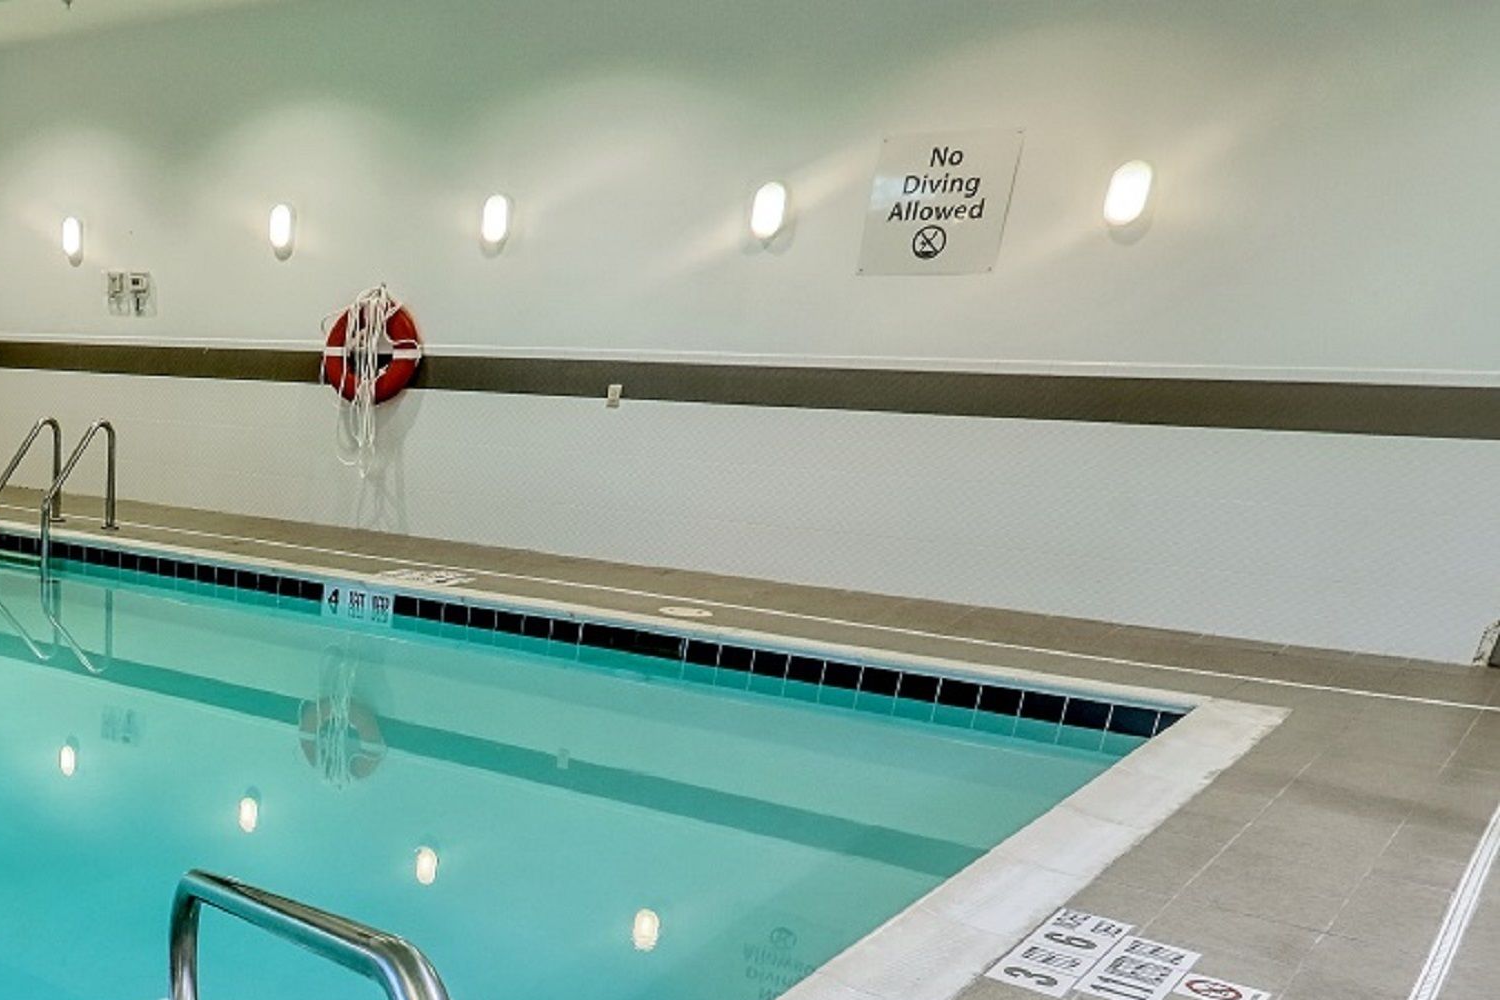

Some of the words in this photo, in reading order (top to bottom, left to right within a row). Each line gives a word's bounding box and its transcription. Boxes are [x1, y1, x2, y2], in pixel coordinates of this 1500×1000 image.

[930, 147, 963, 167] No
[903, 173, 981, 198] Diving
[887, 198, 987, 222] Allowed
[1003, 966, 1058, 987] 3
[1043, 932, 1098, 949] 6
